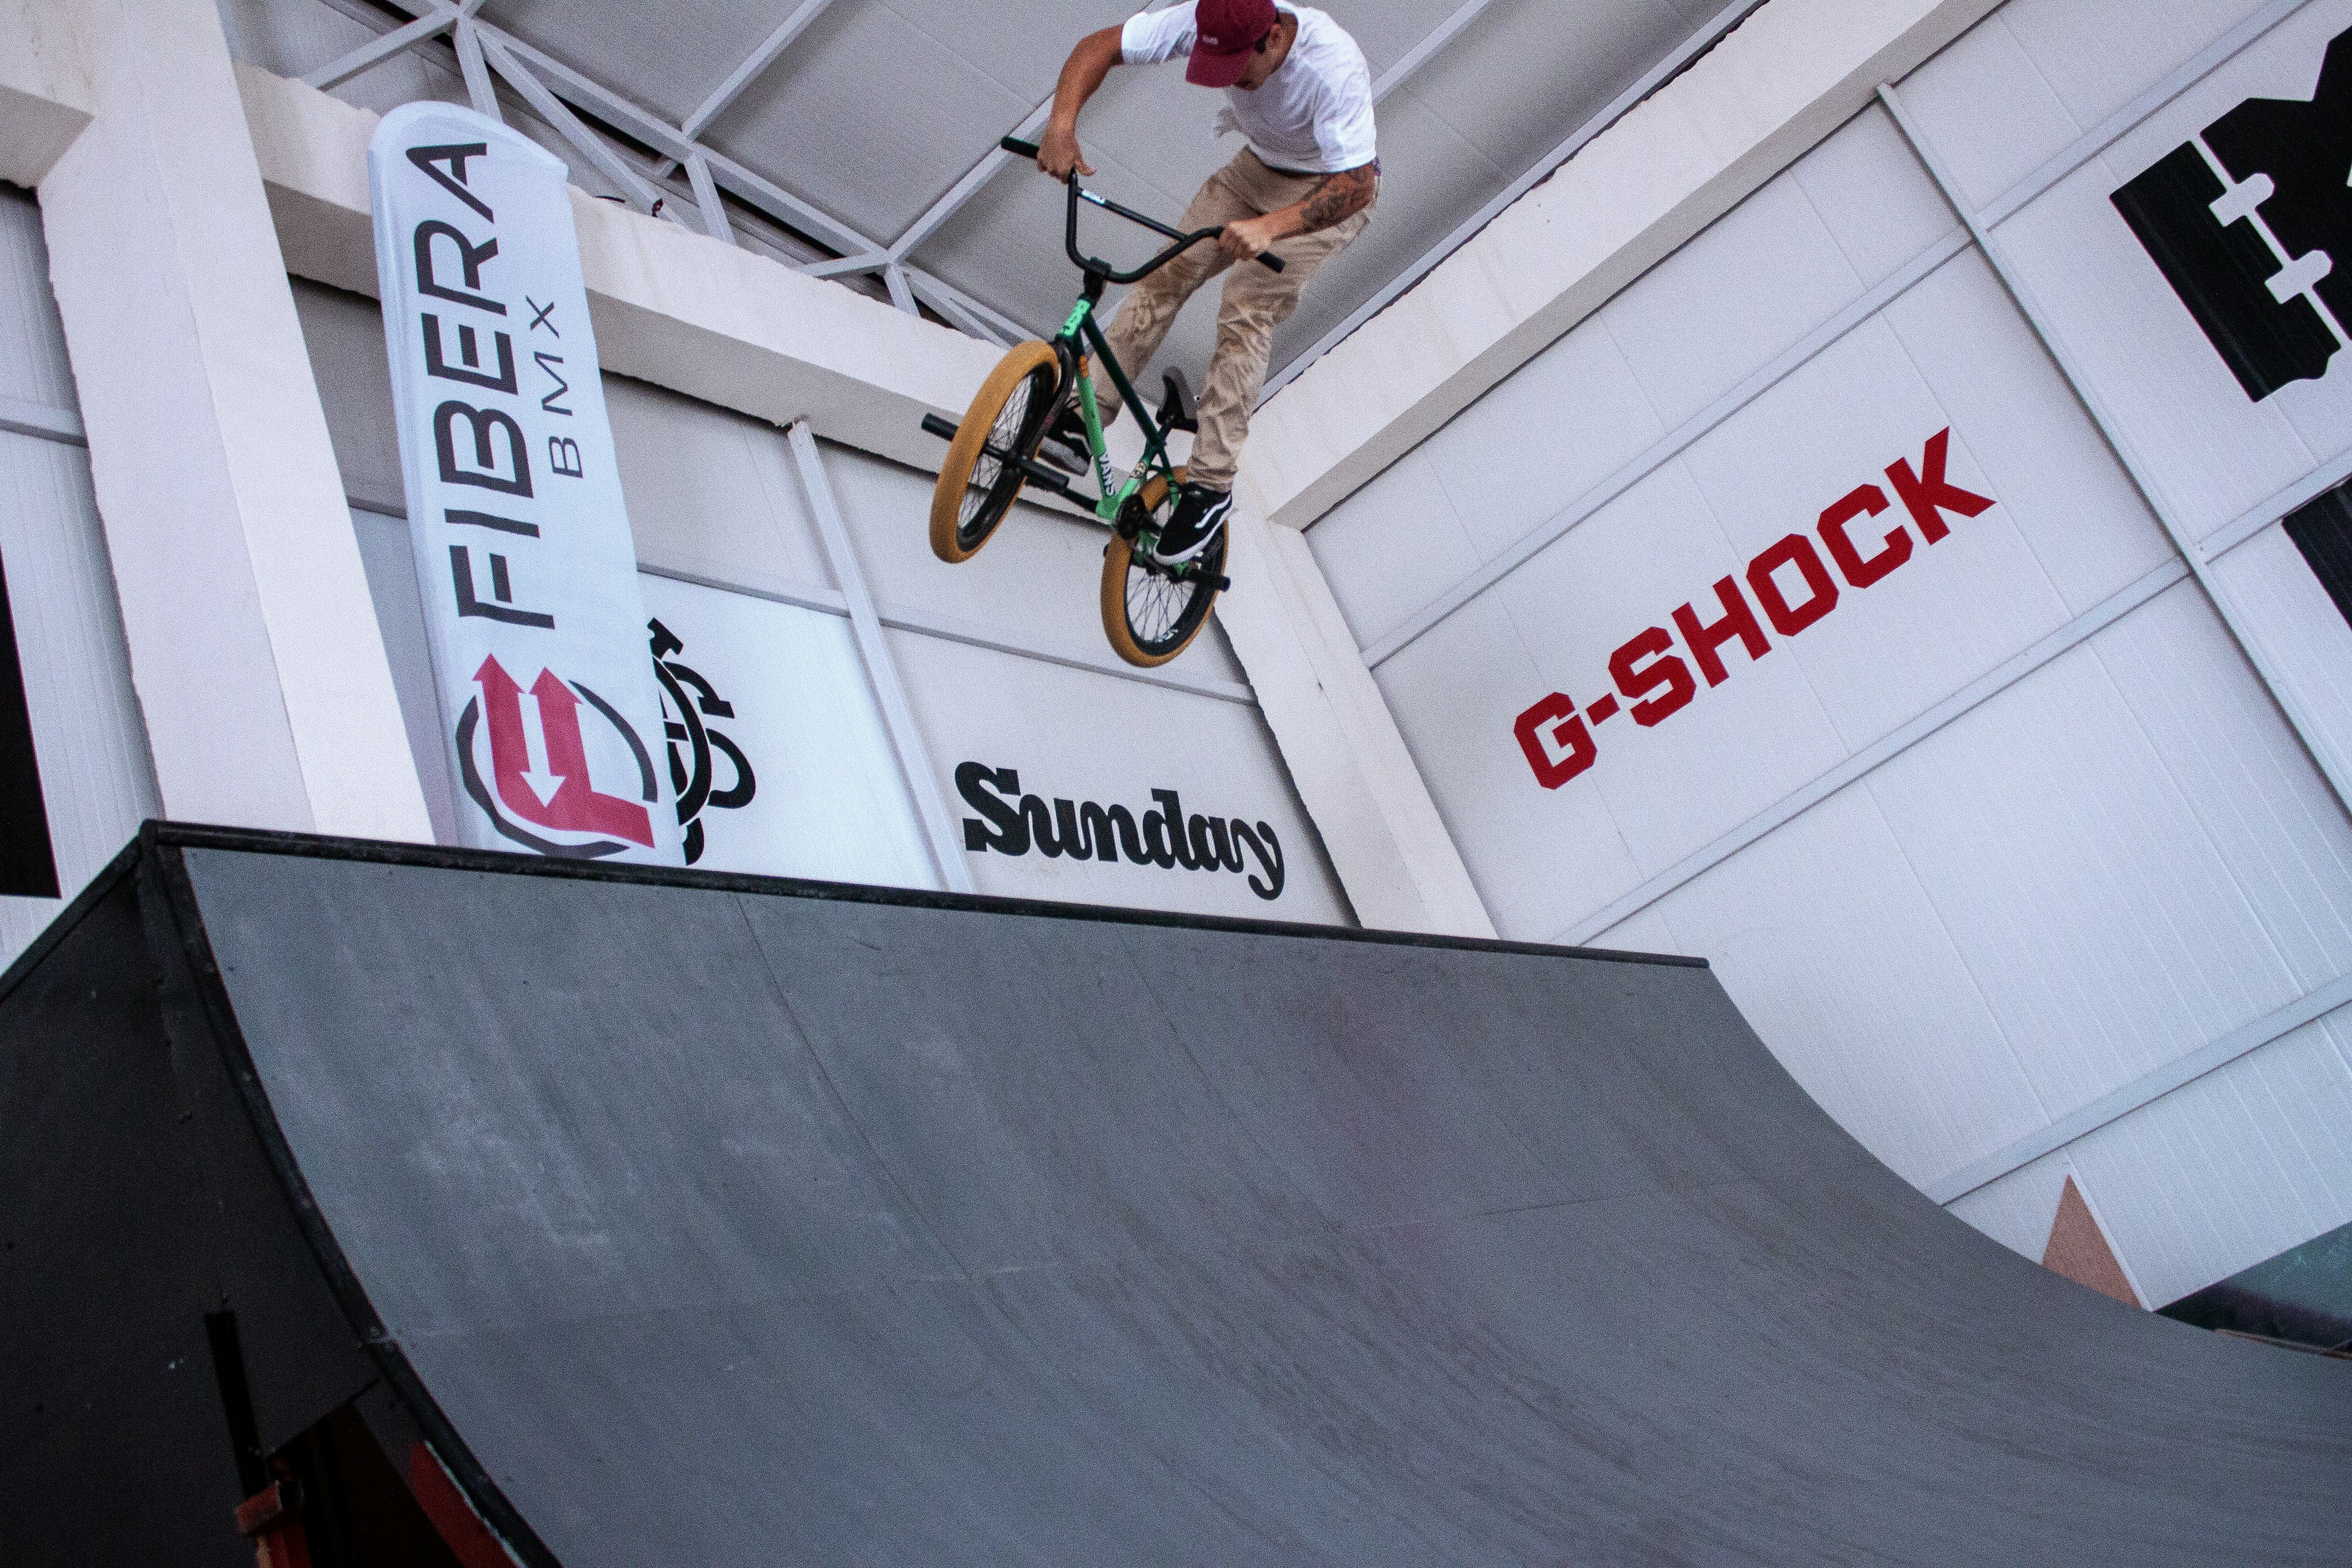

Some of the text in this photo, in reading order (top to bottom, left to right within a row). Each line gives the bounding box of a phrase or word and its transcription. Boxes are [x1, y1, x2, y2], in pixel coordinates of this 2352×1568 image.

[405, 142, 555, 630] FIBERA
[526, 295, 584, 479] BMX
[1099, 451, 1115, 496] VANS
[1513, 425, 1997, 790] G-SHOCK
[954, 761, 1285, 901] Sunday
